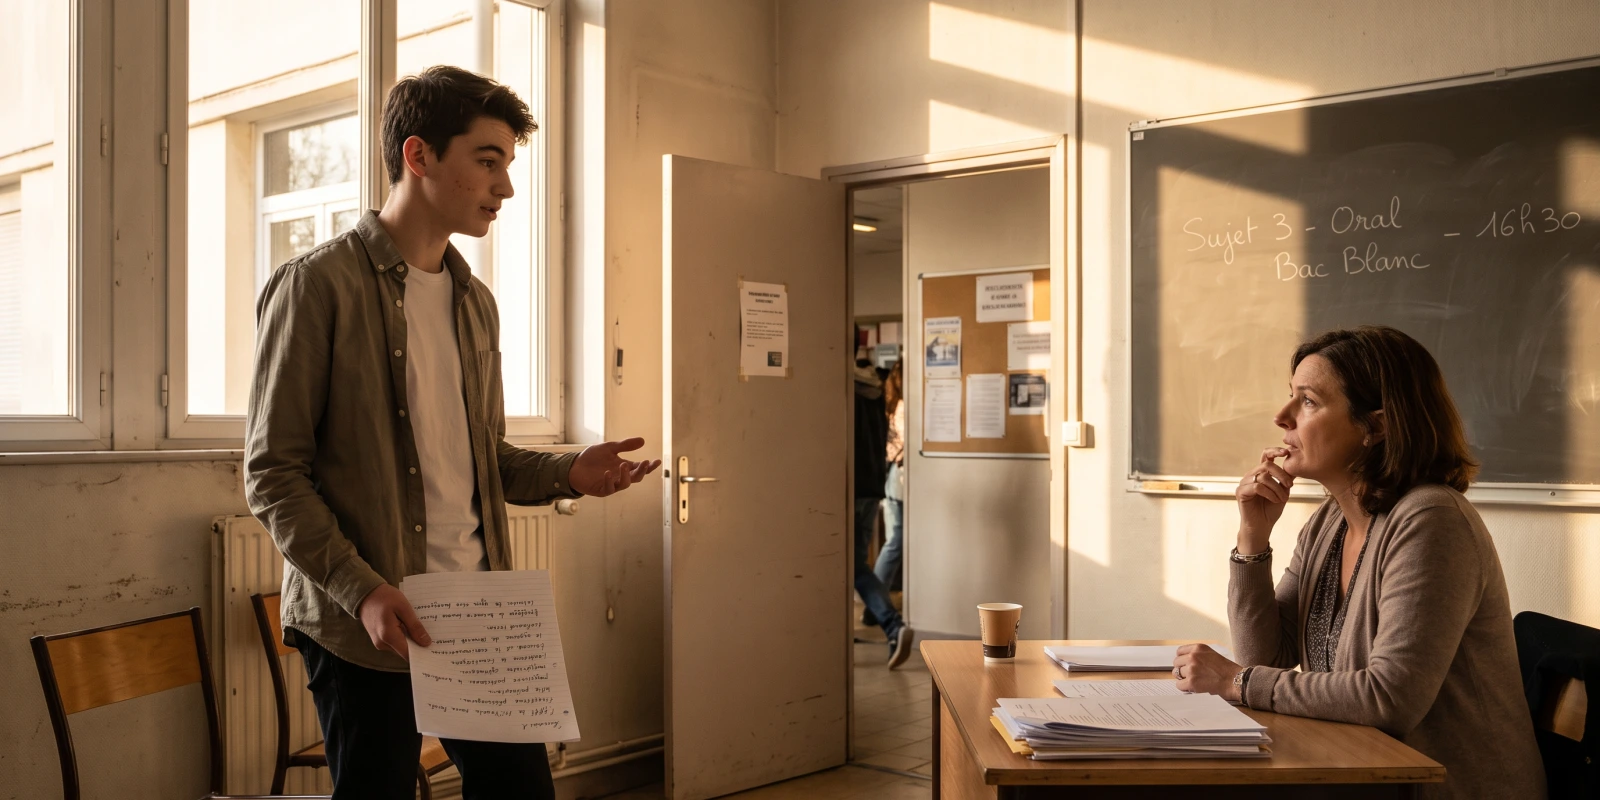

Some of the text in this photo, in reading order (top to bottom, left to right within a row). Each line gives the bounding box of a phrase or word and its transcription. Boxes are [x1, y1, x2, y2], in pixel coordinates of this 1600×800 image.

[1182, 216, 1258, 264] Sujet
[1273, 213, 1292, 241] 3
[1331, 196, 1402, 234] Oral
[1476, 202, 1581, 238] 16h30
[1274, 241, 1431, 281] Bac Blanc
